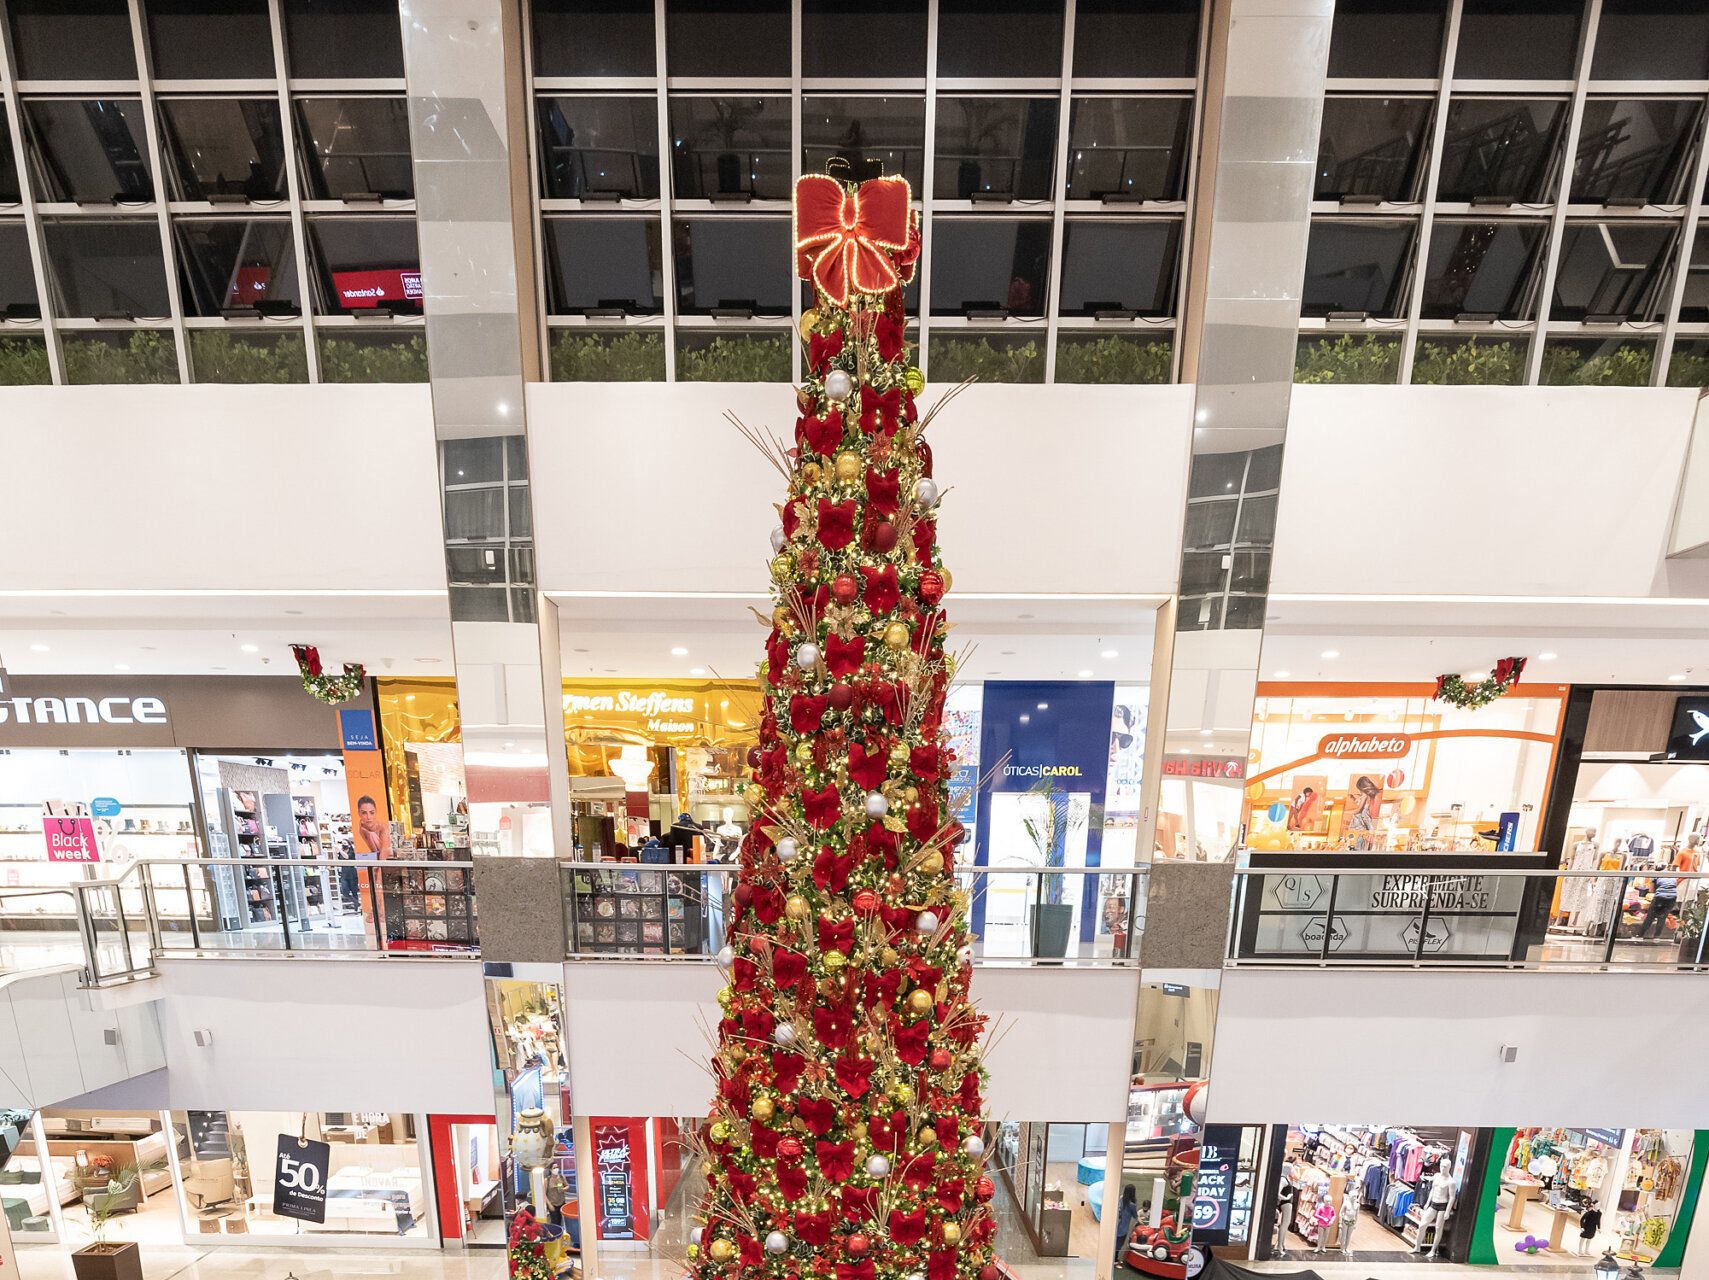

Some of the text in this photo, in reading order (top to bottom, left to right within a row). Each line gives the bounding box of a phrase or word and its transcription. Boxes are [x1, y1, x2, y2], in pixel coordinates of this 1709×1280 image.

[615, 691, 694, 717] Steffens
[647, 719, 694, 732] Maison
[1324, 736, 1405, 757] alphabeto
[1003, 763, 1083, 776] ÓTICAS CAROL
[52, 832, 89, 848] Black
[53, 847, 92, 860] week
[1382, 874, 1485, 892] EXPERMENTE
[1408, 937, 1443, 946] PISFLEX
[279, 1152, 291, 1160] Até
[1197, 1175, 1226, 1185] ACK
[298, 1191, 324, 1202] Desconto
